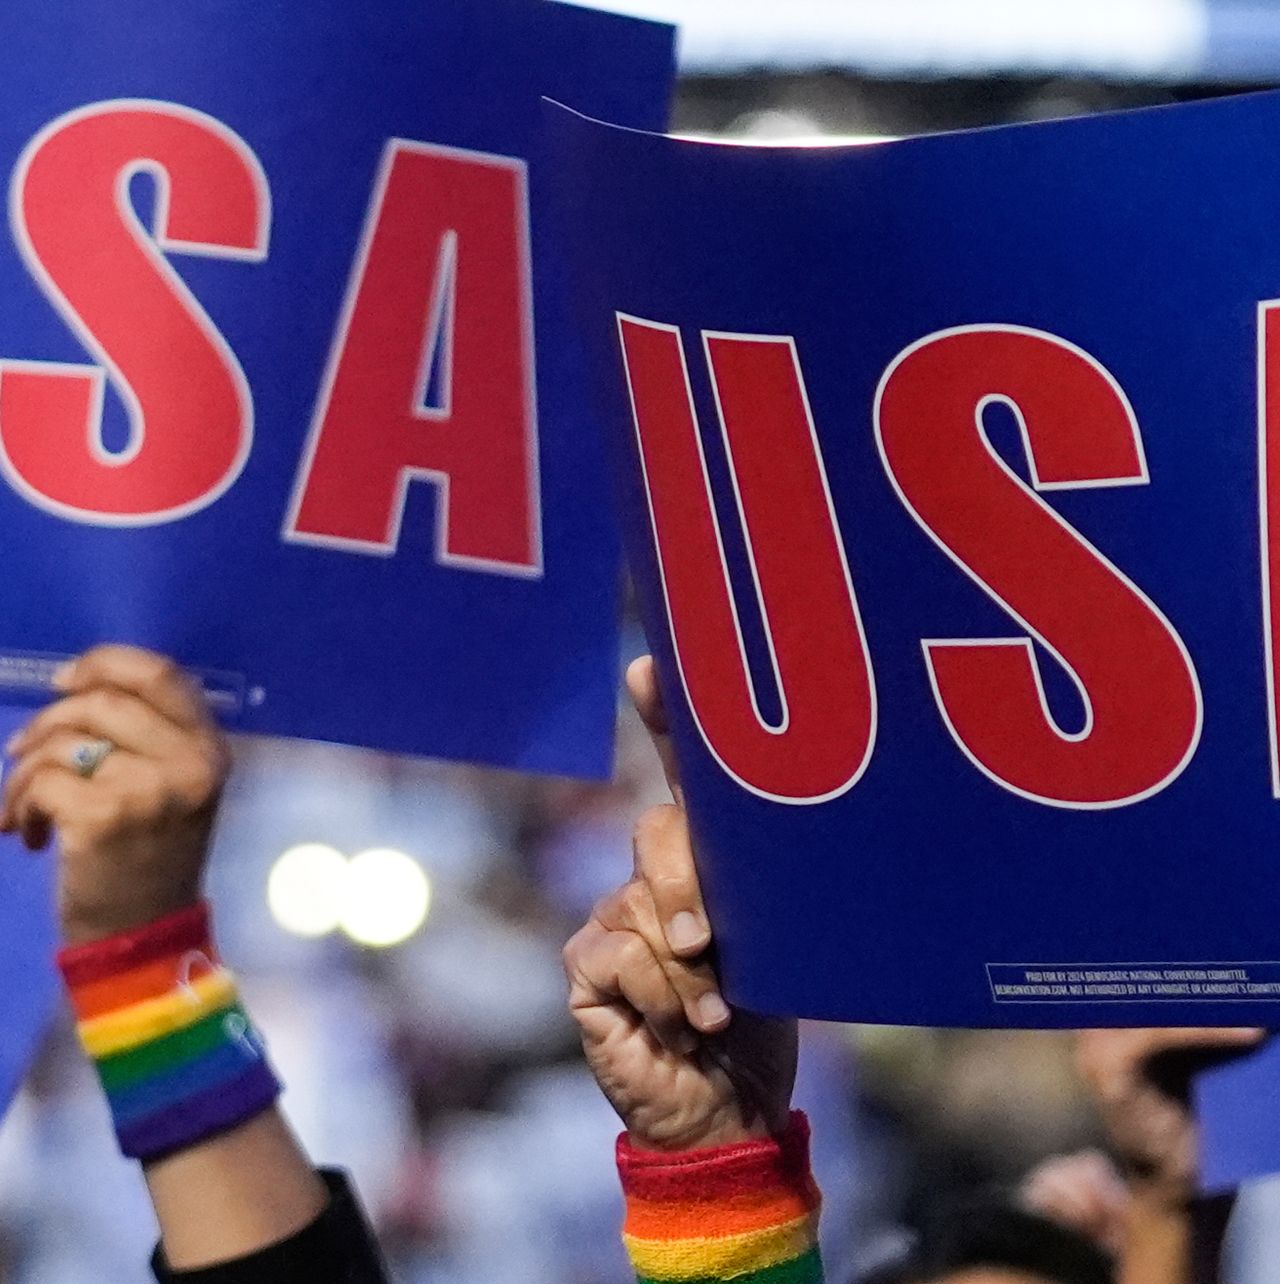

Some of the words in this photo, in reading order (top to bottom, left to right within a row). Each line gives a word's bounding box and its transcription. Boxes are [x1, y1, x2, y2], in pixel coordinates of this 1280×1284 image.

[1085, 970, 1129, 982] DEMOCRATIC
[1129, 970, 1163, 981] NATIONAL
[1163, 970, 1207, 981] CONVENTION
